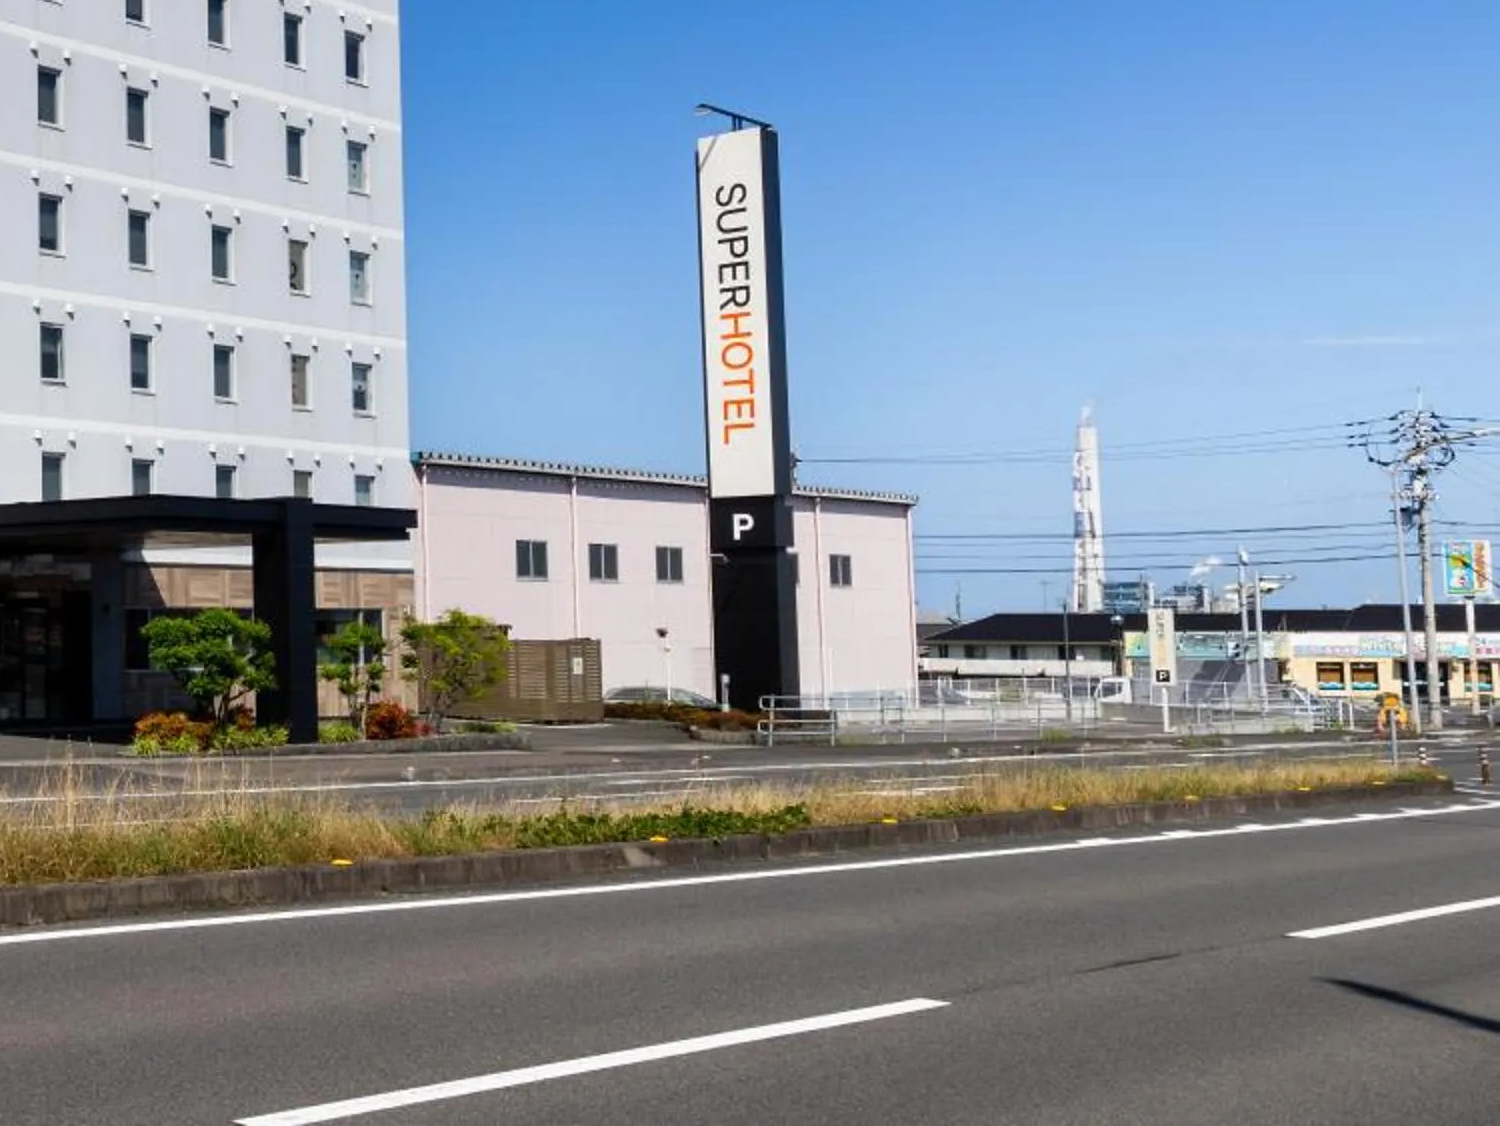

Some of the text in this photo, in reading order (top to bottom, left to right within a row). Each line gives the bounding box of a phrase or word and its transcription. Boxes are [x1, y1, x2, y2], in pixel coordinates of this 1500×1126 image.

[715, 182, 755, 446] SUPERHOTEL
[732, 513, 755, 542] P
[1159, 670, 1169, 681] P
